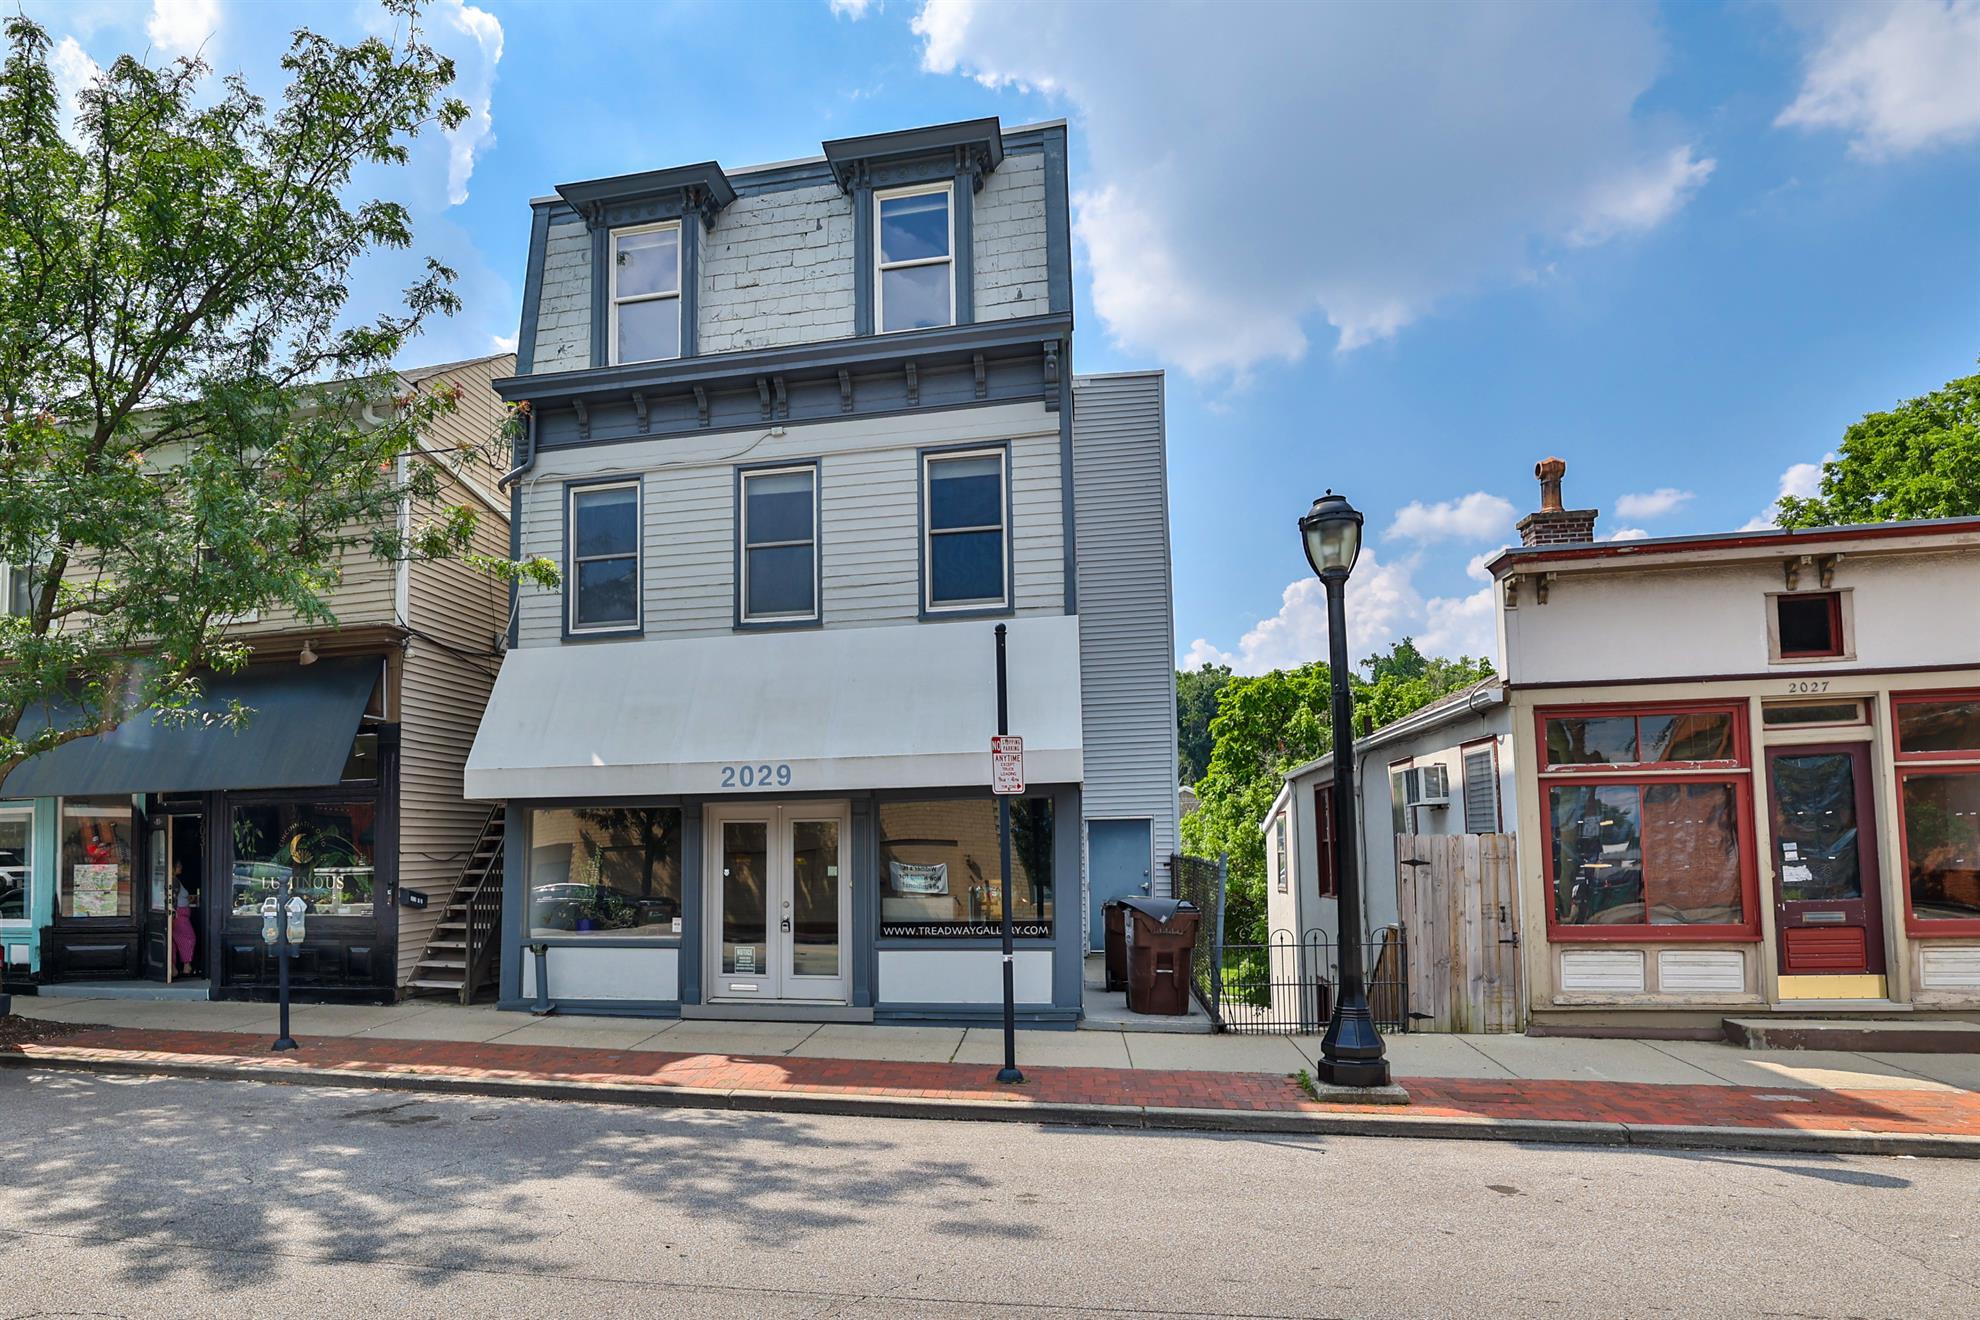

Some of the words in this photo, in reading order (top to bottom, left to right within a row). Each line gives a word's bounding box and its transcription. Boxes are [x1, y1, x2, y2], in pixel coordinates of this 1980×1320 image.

[1789, 681, 1830, 693] 2027
[992, 740, 1001, 751] NO
[721, 764, 791, 787] 2029
[883, 926, 1049, 935] WWW.TREADWAYGALLRY.COM
